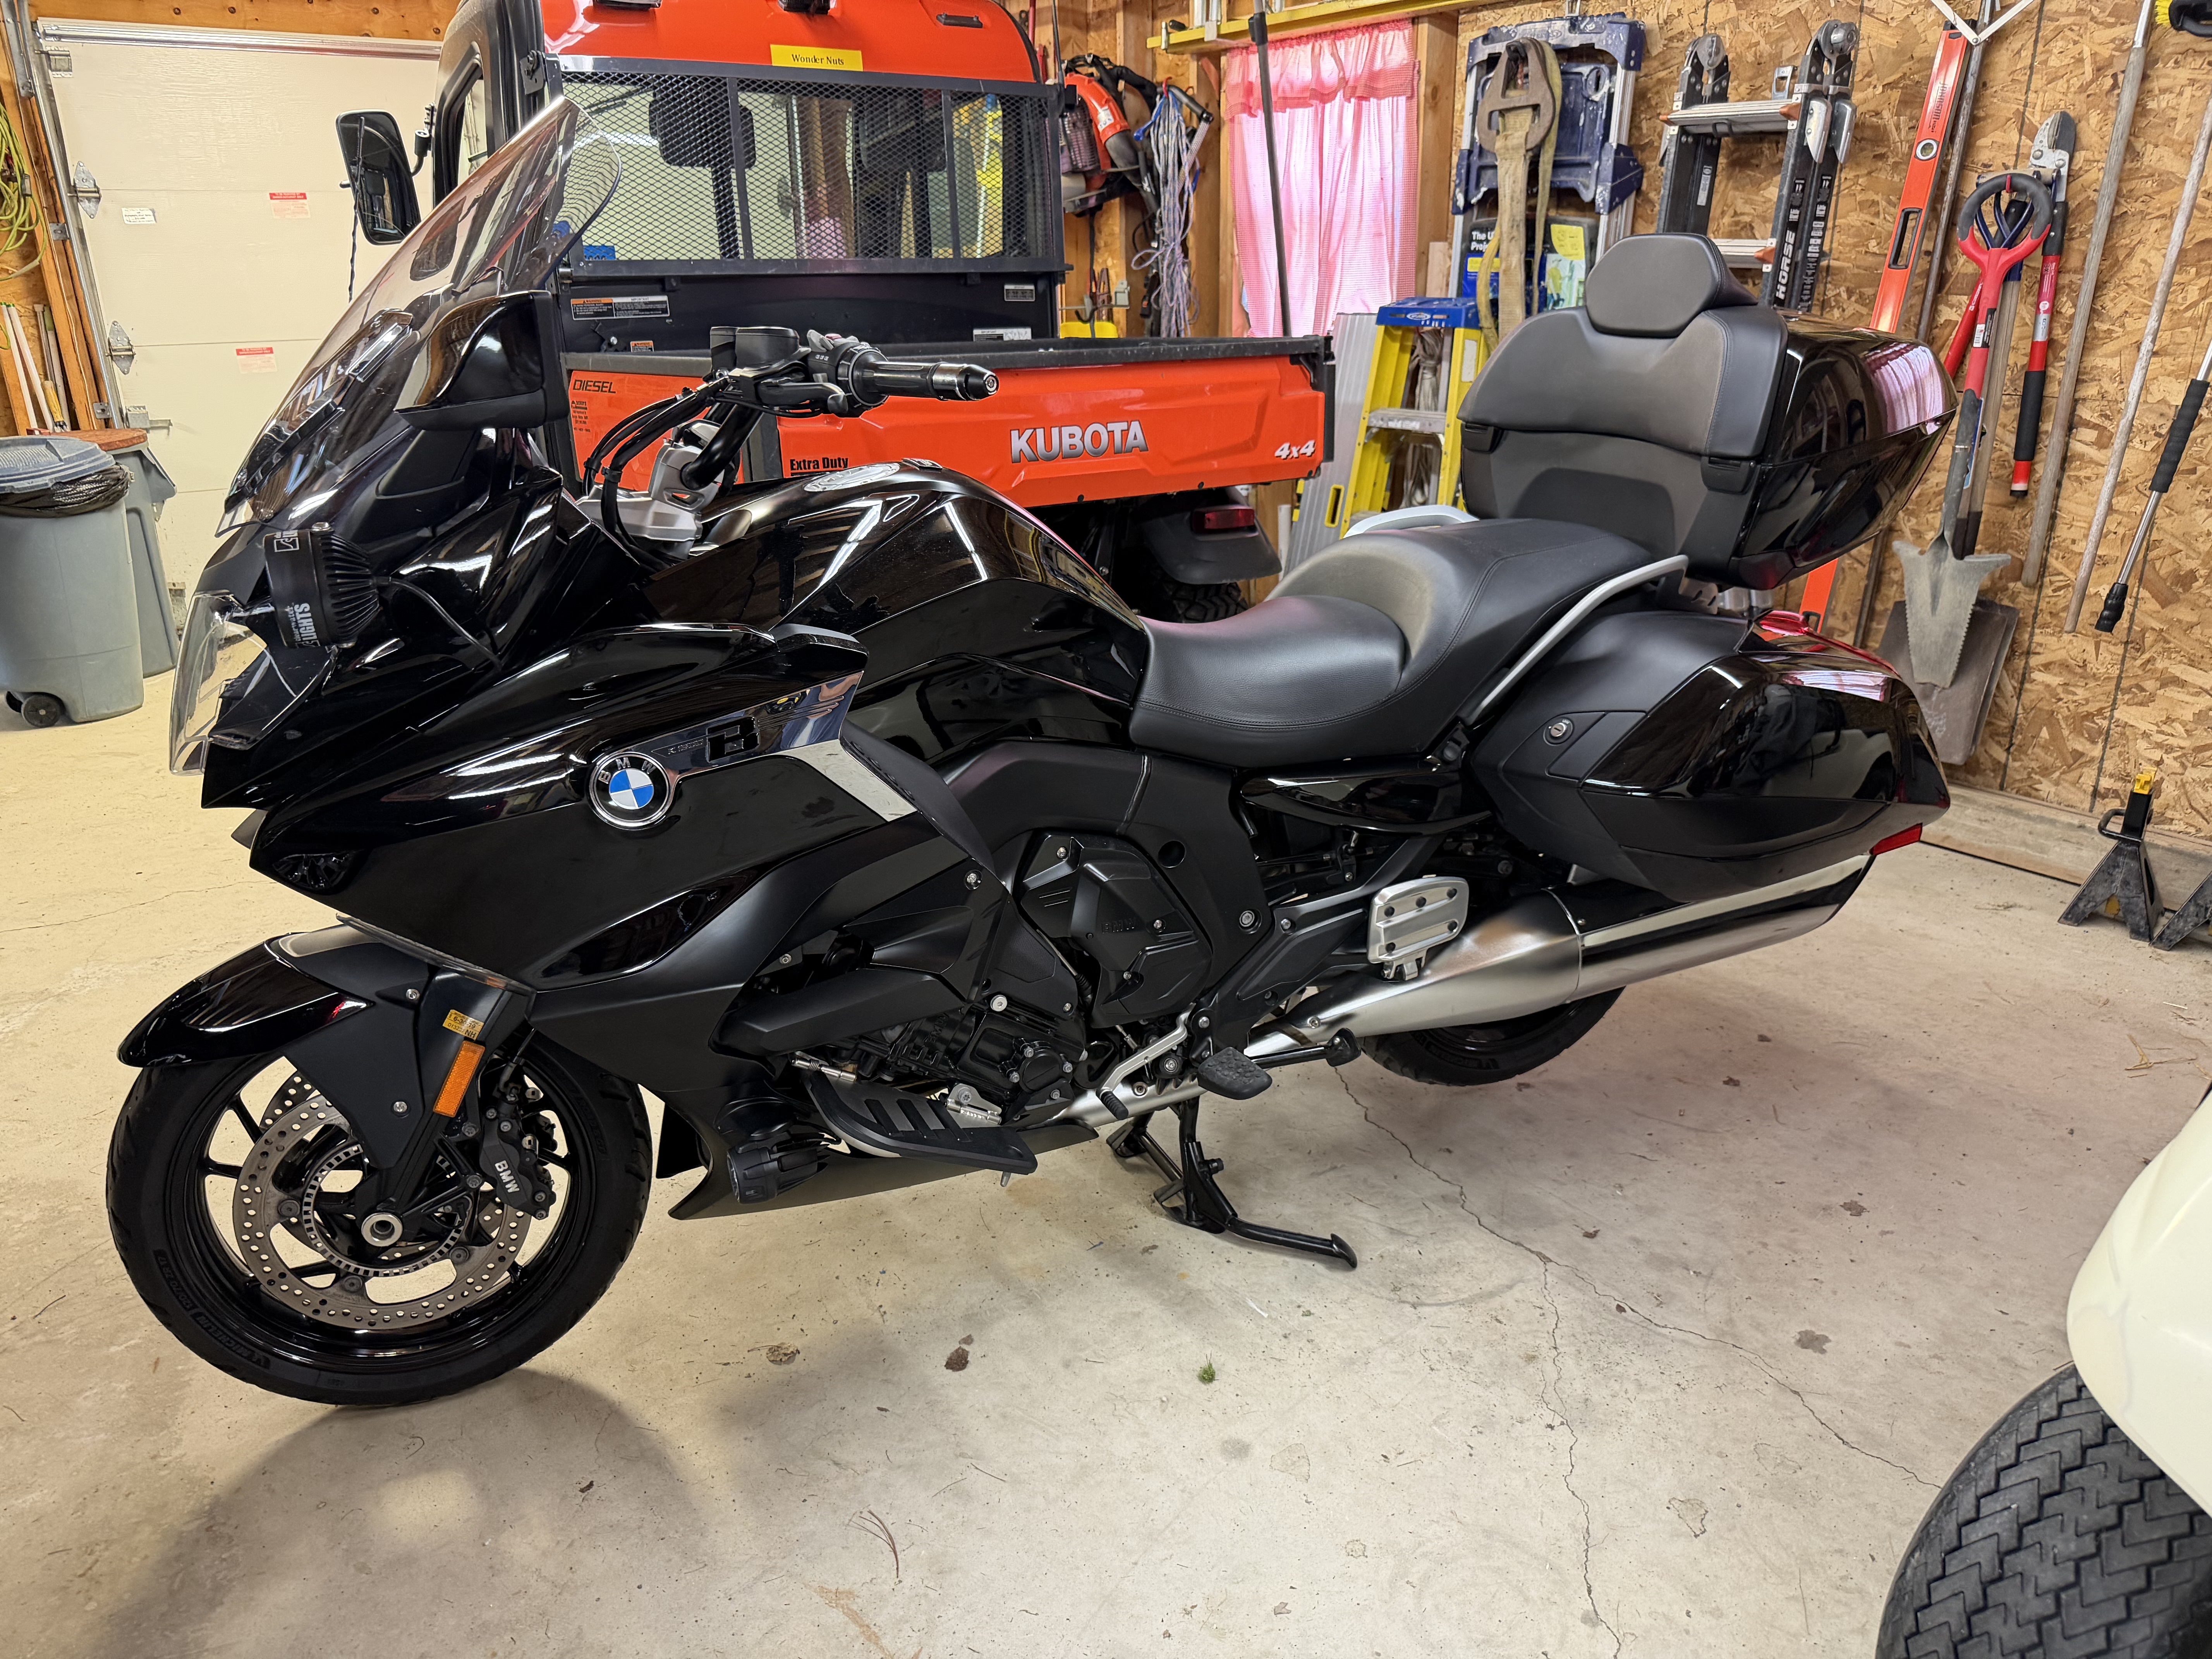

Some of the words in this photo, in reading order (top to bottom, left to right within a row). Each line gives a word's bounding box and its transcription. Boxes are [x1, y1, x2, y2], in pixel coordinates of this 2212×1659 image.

[792, 54, 824, 64] Wonder
[826, 57, 844, 65] Nuts
[1472, 231, 1486, 240] The
[1471, 241, 1488, 252] Proj
[1776, 230, 1796, 300] HORSE
[573, 379, 616, 393] DIESEL
[1010, 419, 1149, 464] KUBOTA
[1274, 439, 1316, 460] 4x4
[790, 459, 819, 471] Extra
[822, 457, 848, 469] Duty
[294, 603, 317, 641] LIGHTS
[598, 757, 656, 785] BMW
[465, 1029, 477, 1038] NH
[495, 1160, 520, 1193] BMW
